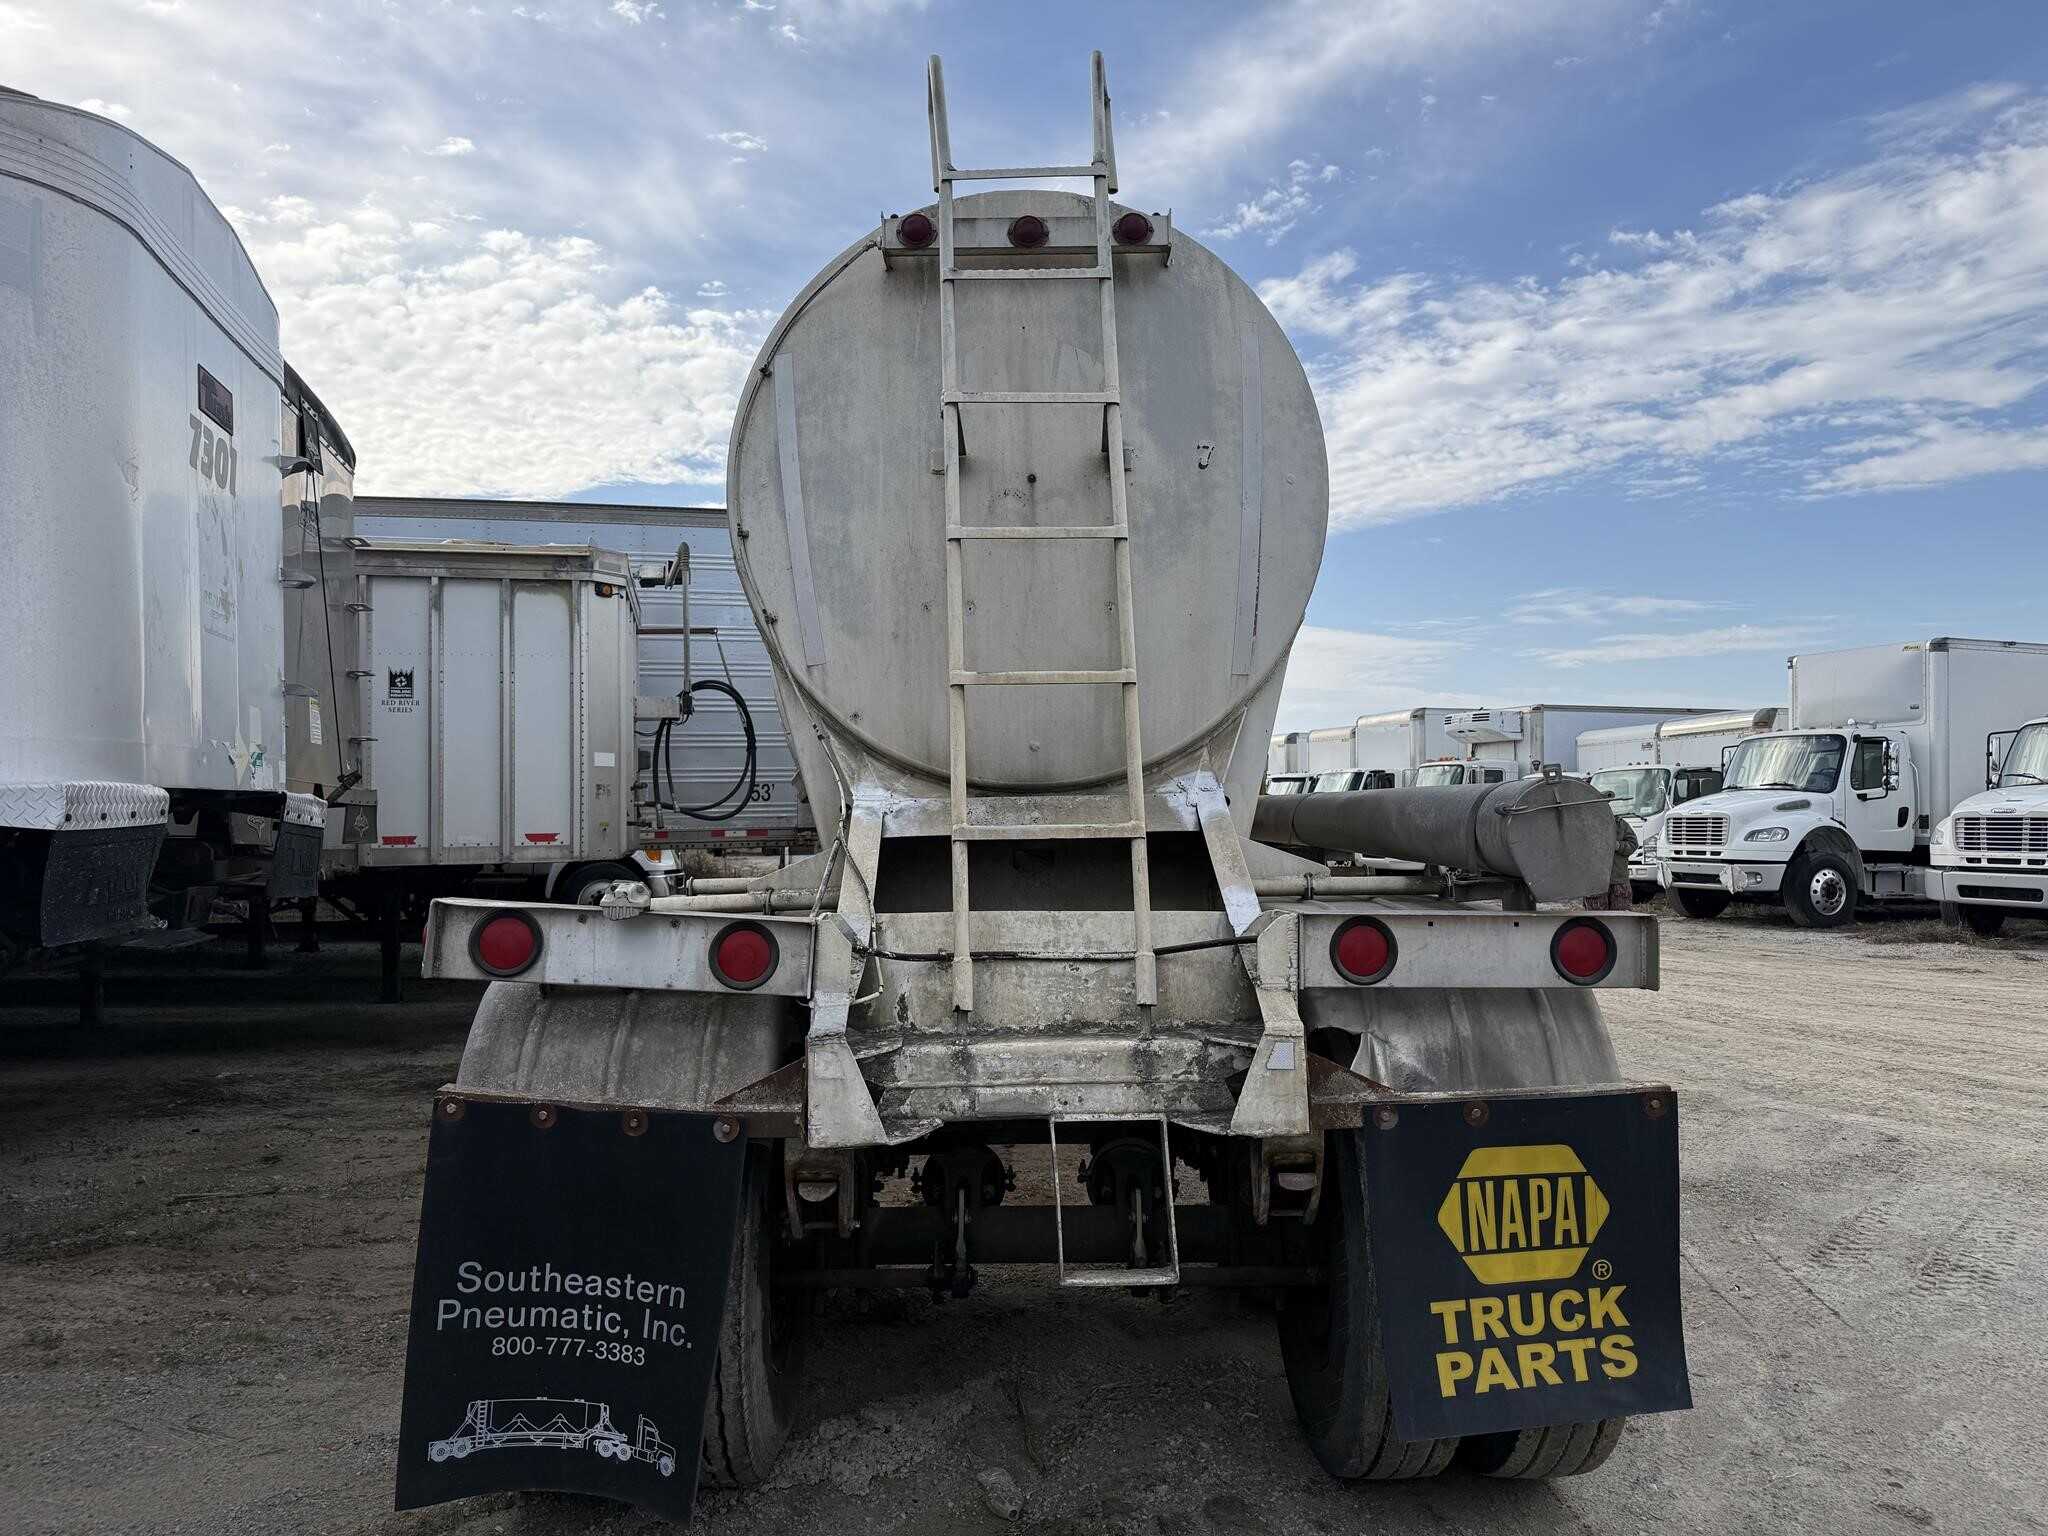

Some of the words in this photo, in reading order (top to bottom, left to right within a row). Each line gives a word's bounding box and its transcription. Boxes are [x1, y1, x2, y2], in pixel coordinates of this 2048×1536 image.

[189, 412, 238, 498] 7301
[1466, 1177, 1581, 1252] NAPA
[456, 1261, 687, 1310] Southeastern
[1429, 1285, 1631, 1345] TRUCK
[437, 1299, 630, 1340] Pneumatic,
[643, 1308, 693, 1349] Inc.
[491, 1336, 647, 1367] 800-777-3383
[1436, 1333, 1639, 1399] PARTS
